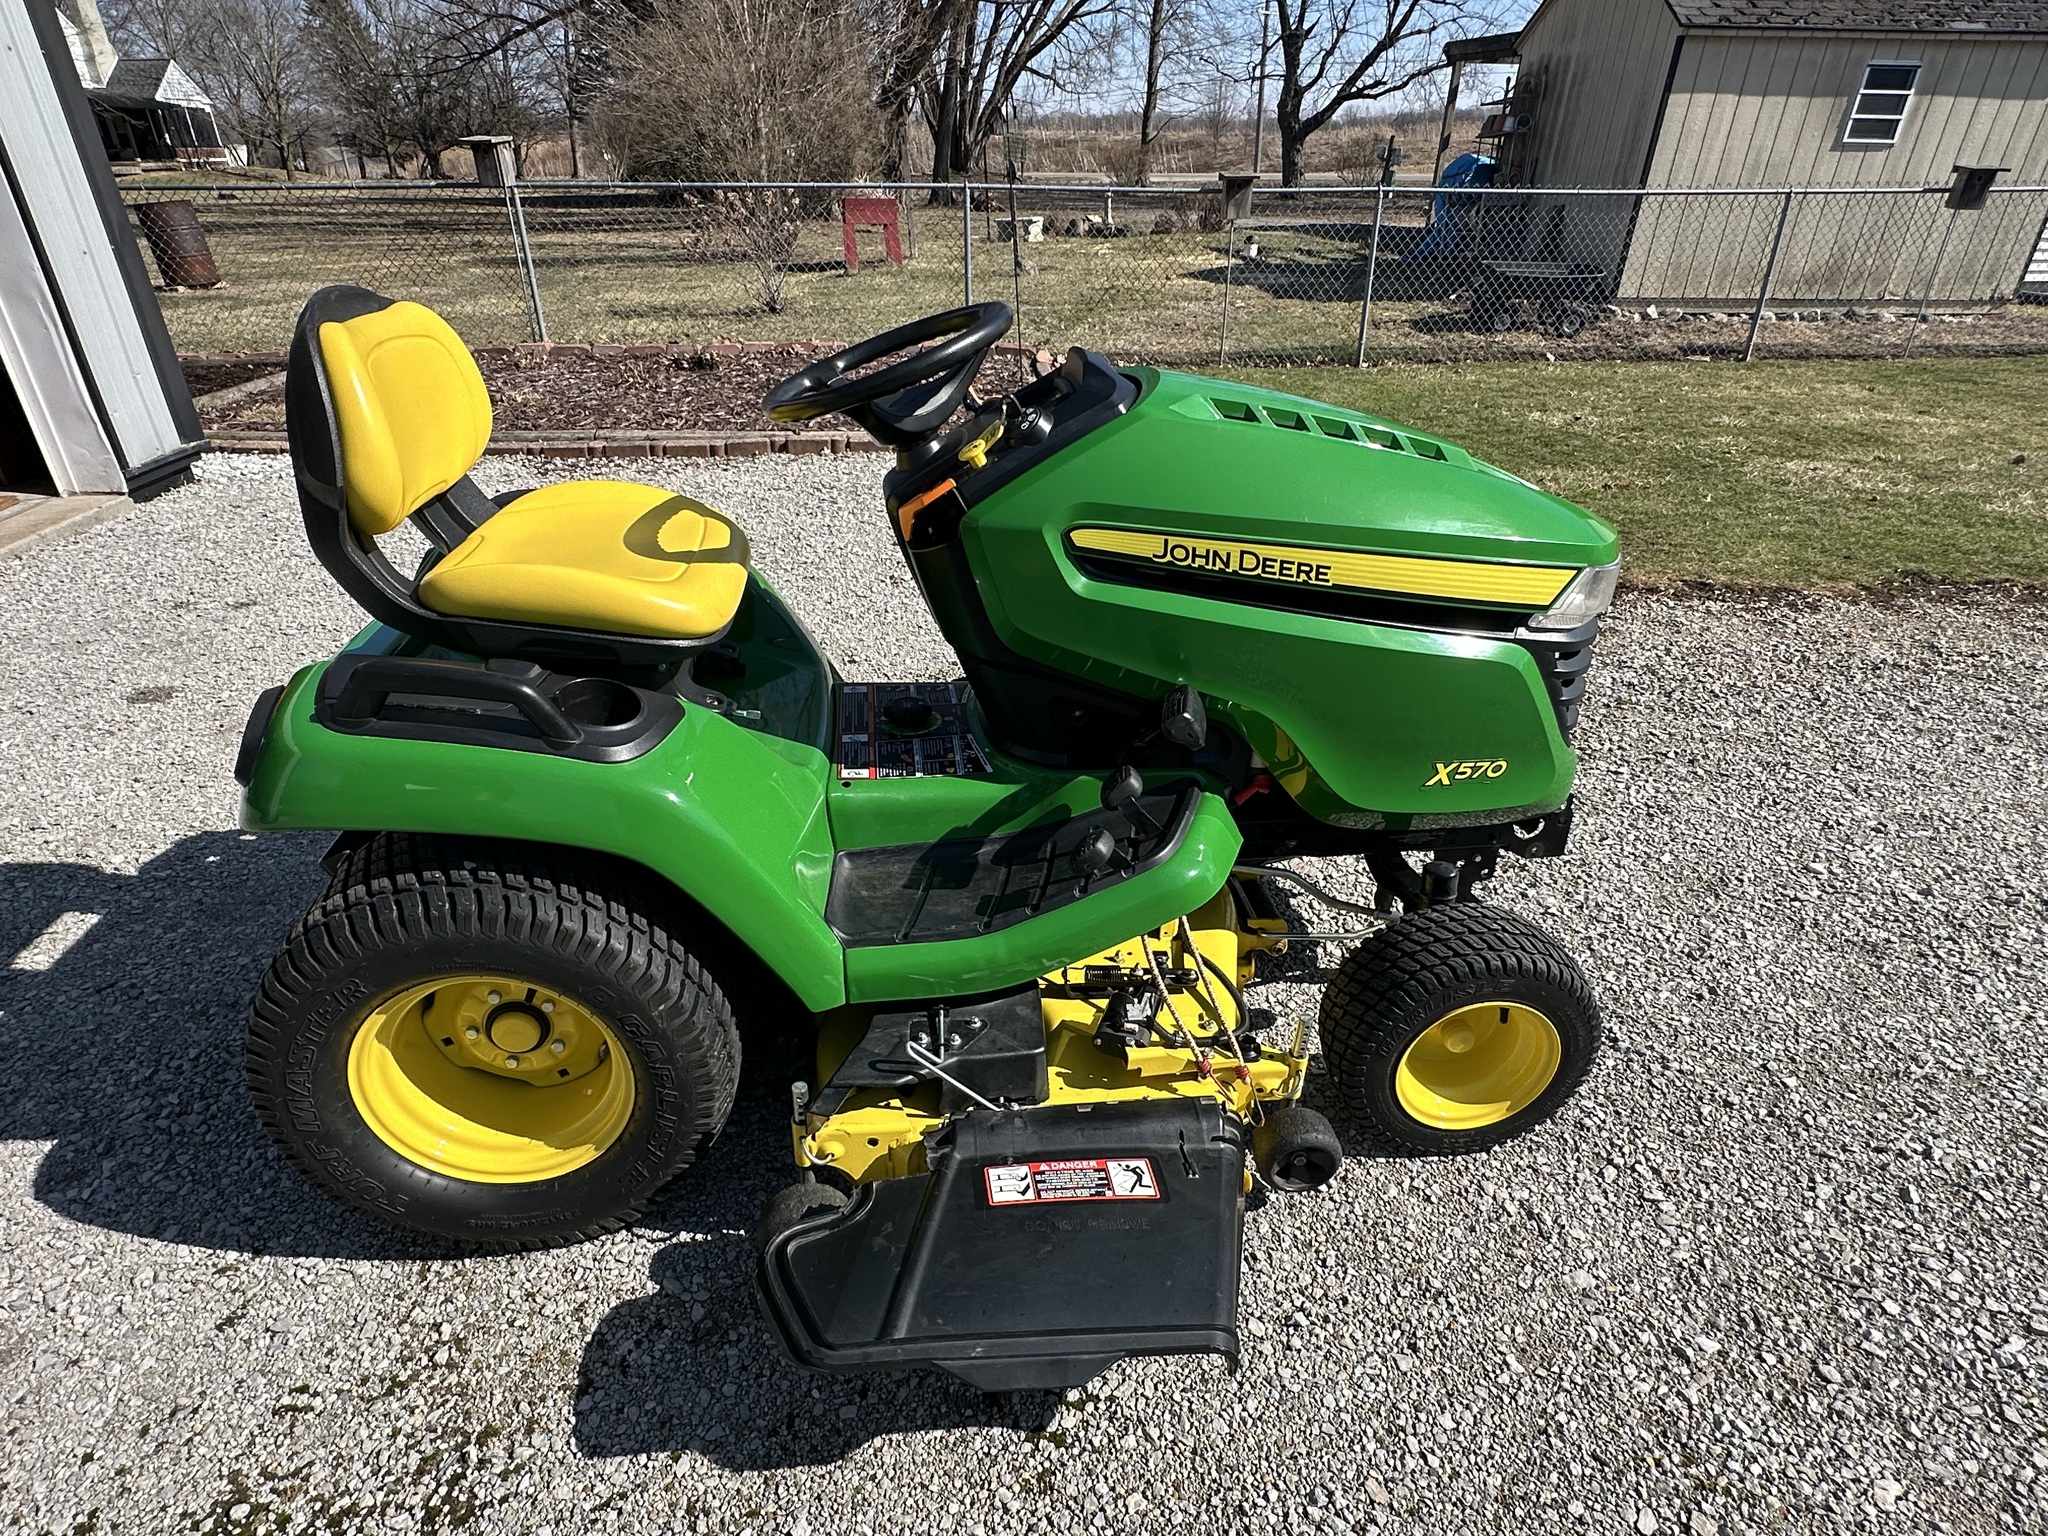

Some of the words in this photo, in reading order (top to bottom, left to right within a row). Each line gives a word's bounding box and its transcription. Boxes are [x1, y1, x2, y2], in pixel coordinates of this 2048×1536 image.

[1152, 538, 1232, 572] JOHN
[1239, 549, 1333, 586] DEERE
[1423, 759, 1509, 787] X570
[286, 979, 369, 1133] MASTER
[616, 1013, 678, 1192] CARLISLE
[305, 1137, 409, 1215] TURF
[1051, 1160, 1098, 1170] DANGER
[1024, 1219, 1047, 1232] DO
[1087, 1217, 1152, 1231] REMOVE
